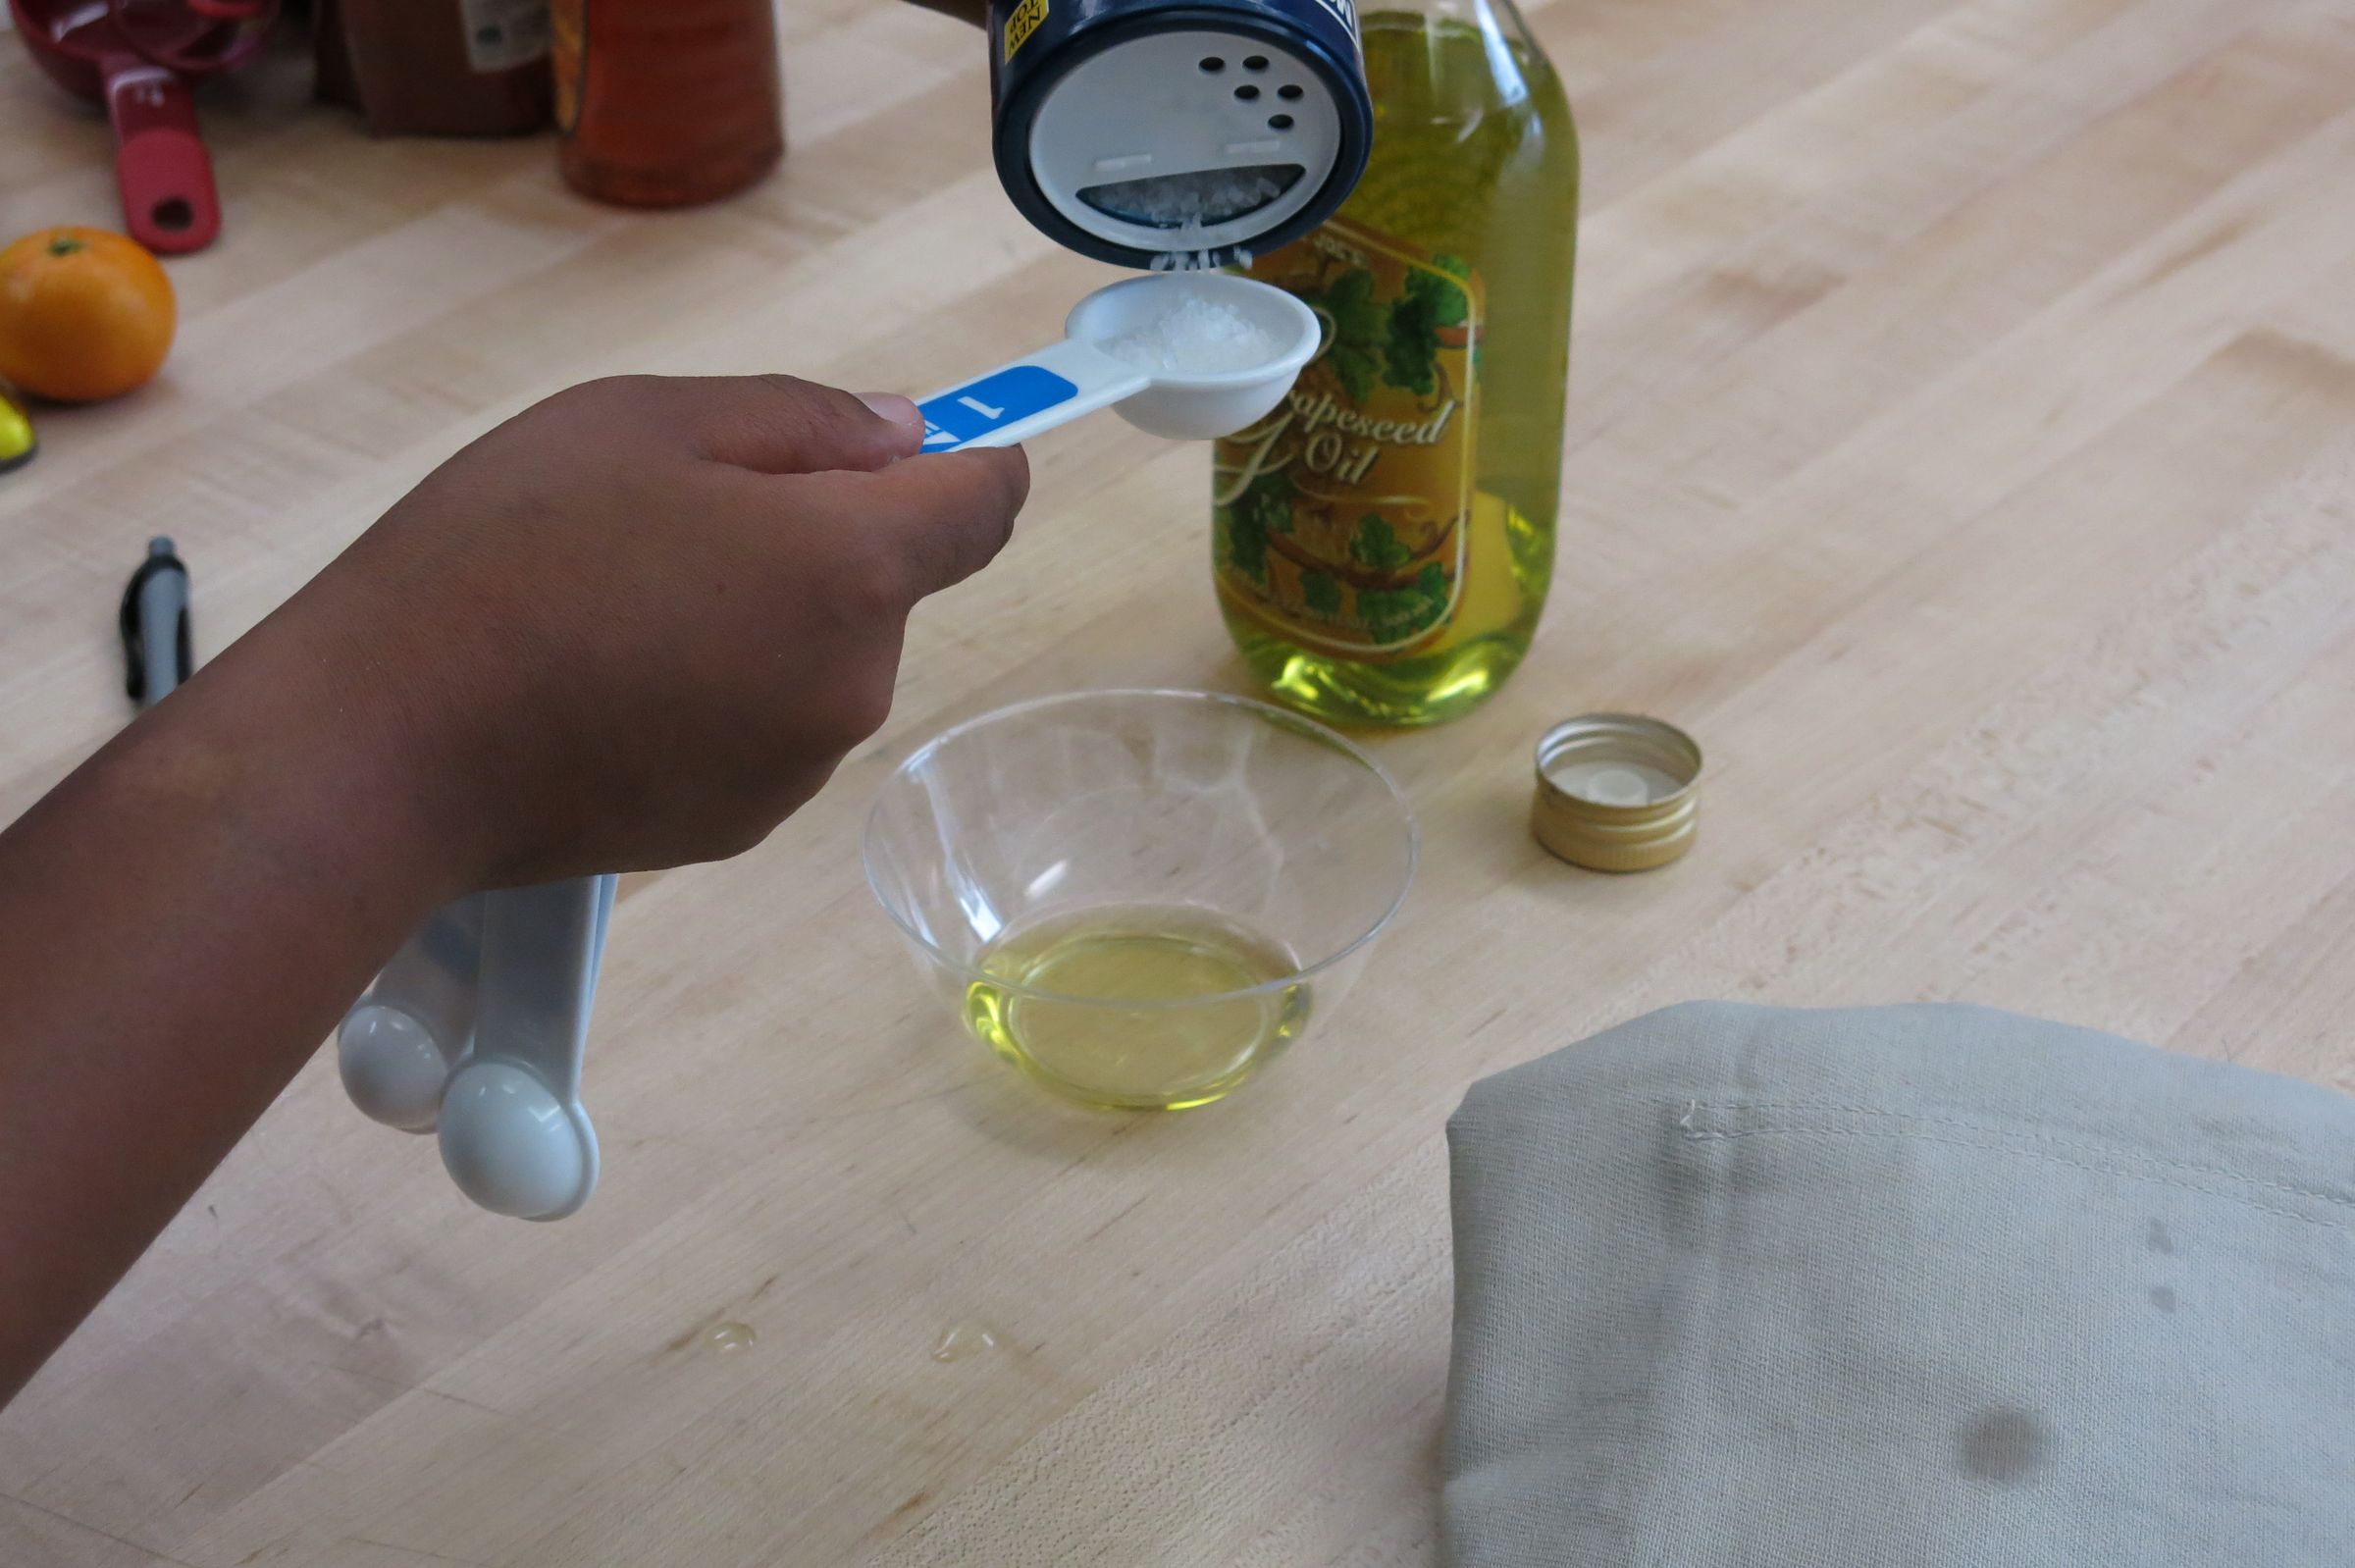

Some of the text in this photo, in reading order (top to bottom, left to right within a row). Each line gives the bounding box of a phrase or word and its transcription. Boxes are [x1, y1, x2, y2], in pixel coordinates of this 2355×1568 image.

[1008, 6, 1040, 56] NEW
[957, 395, 1005, 420] 1
[1304, 431, 1381, 485] Oil
